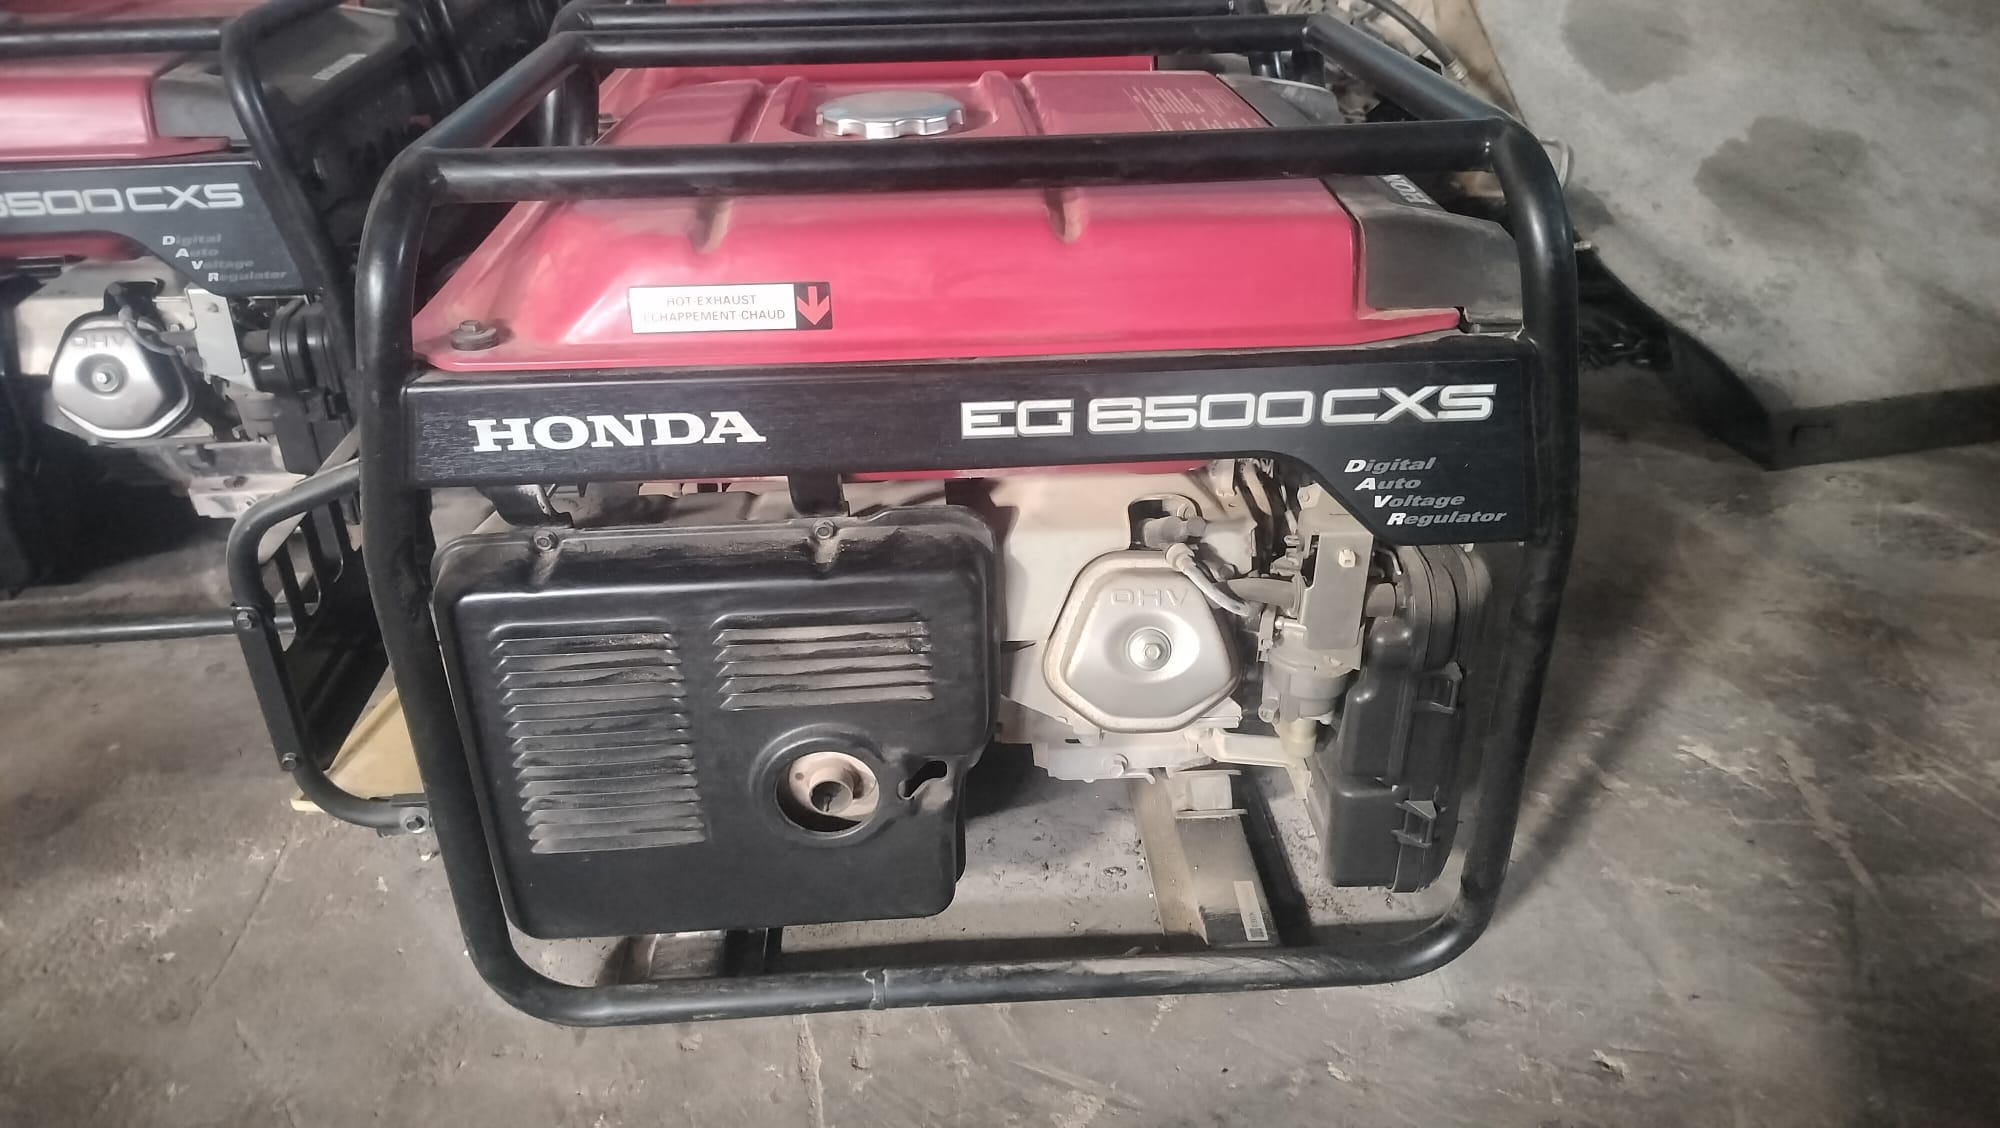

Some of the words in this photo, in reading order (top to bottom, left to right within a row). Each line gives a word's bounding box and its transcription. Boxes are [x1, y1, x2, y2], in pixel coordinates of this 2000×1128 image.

[0, 183, 244, 218] 500CXS
[162, 233, 222, 247] Digital
[175, 247, 219, 259] Auto
[191, 259, 255, 271] Voltage
[208, 270, 288, 283] Regulator
[961, 399, 1075, 439] EG
[467, 411, 767, 452] HONDA
[1344, 456, 1437, 475] Digital
[1354, 477, 1422, 491] Auto
[1374, 494, 1466, 509] Voltage
[1386, 511, 1507, 527] Regulator
[1110, 587, 1189, 608] OHV
